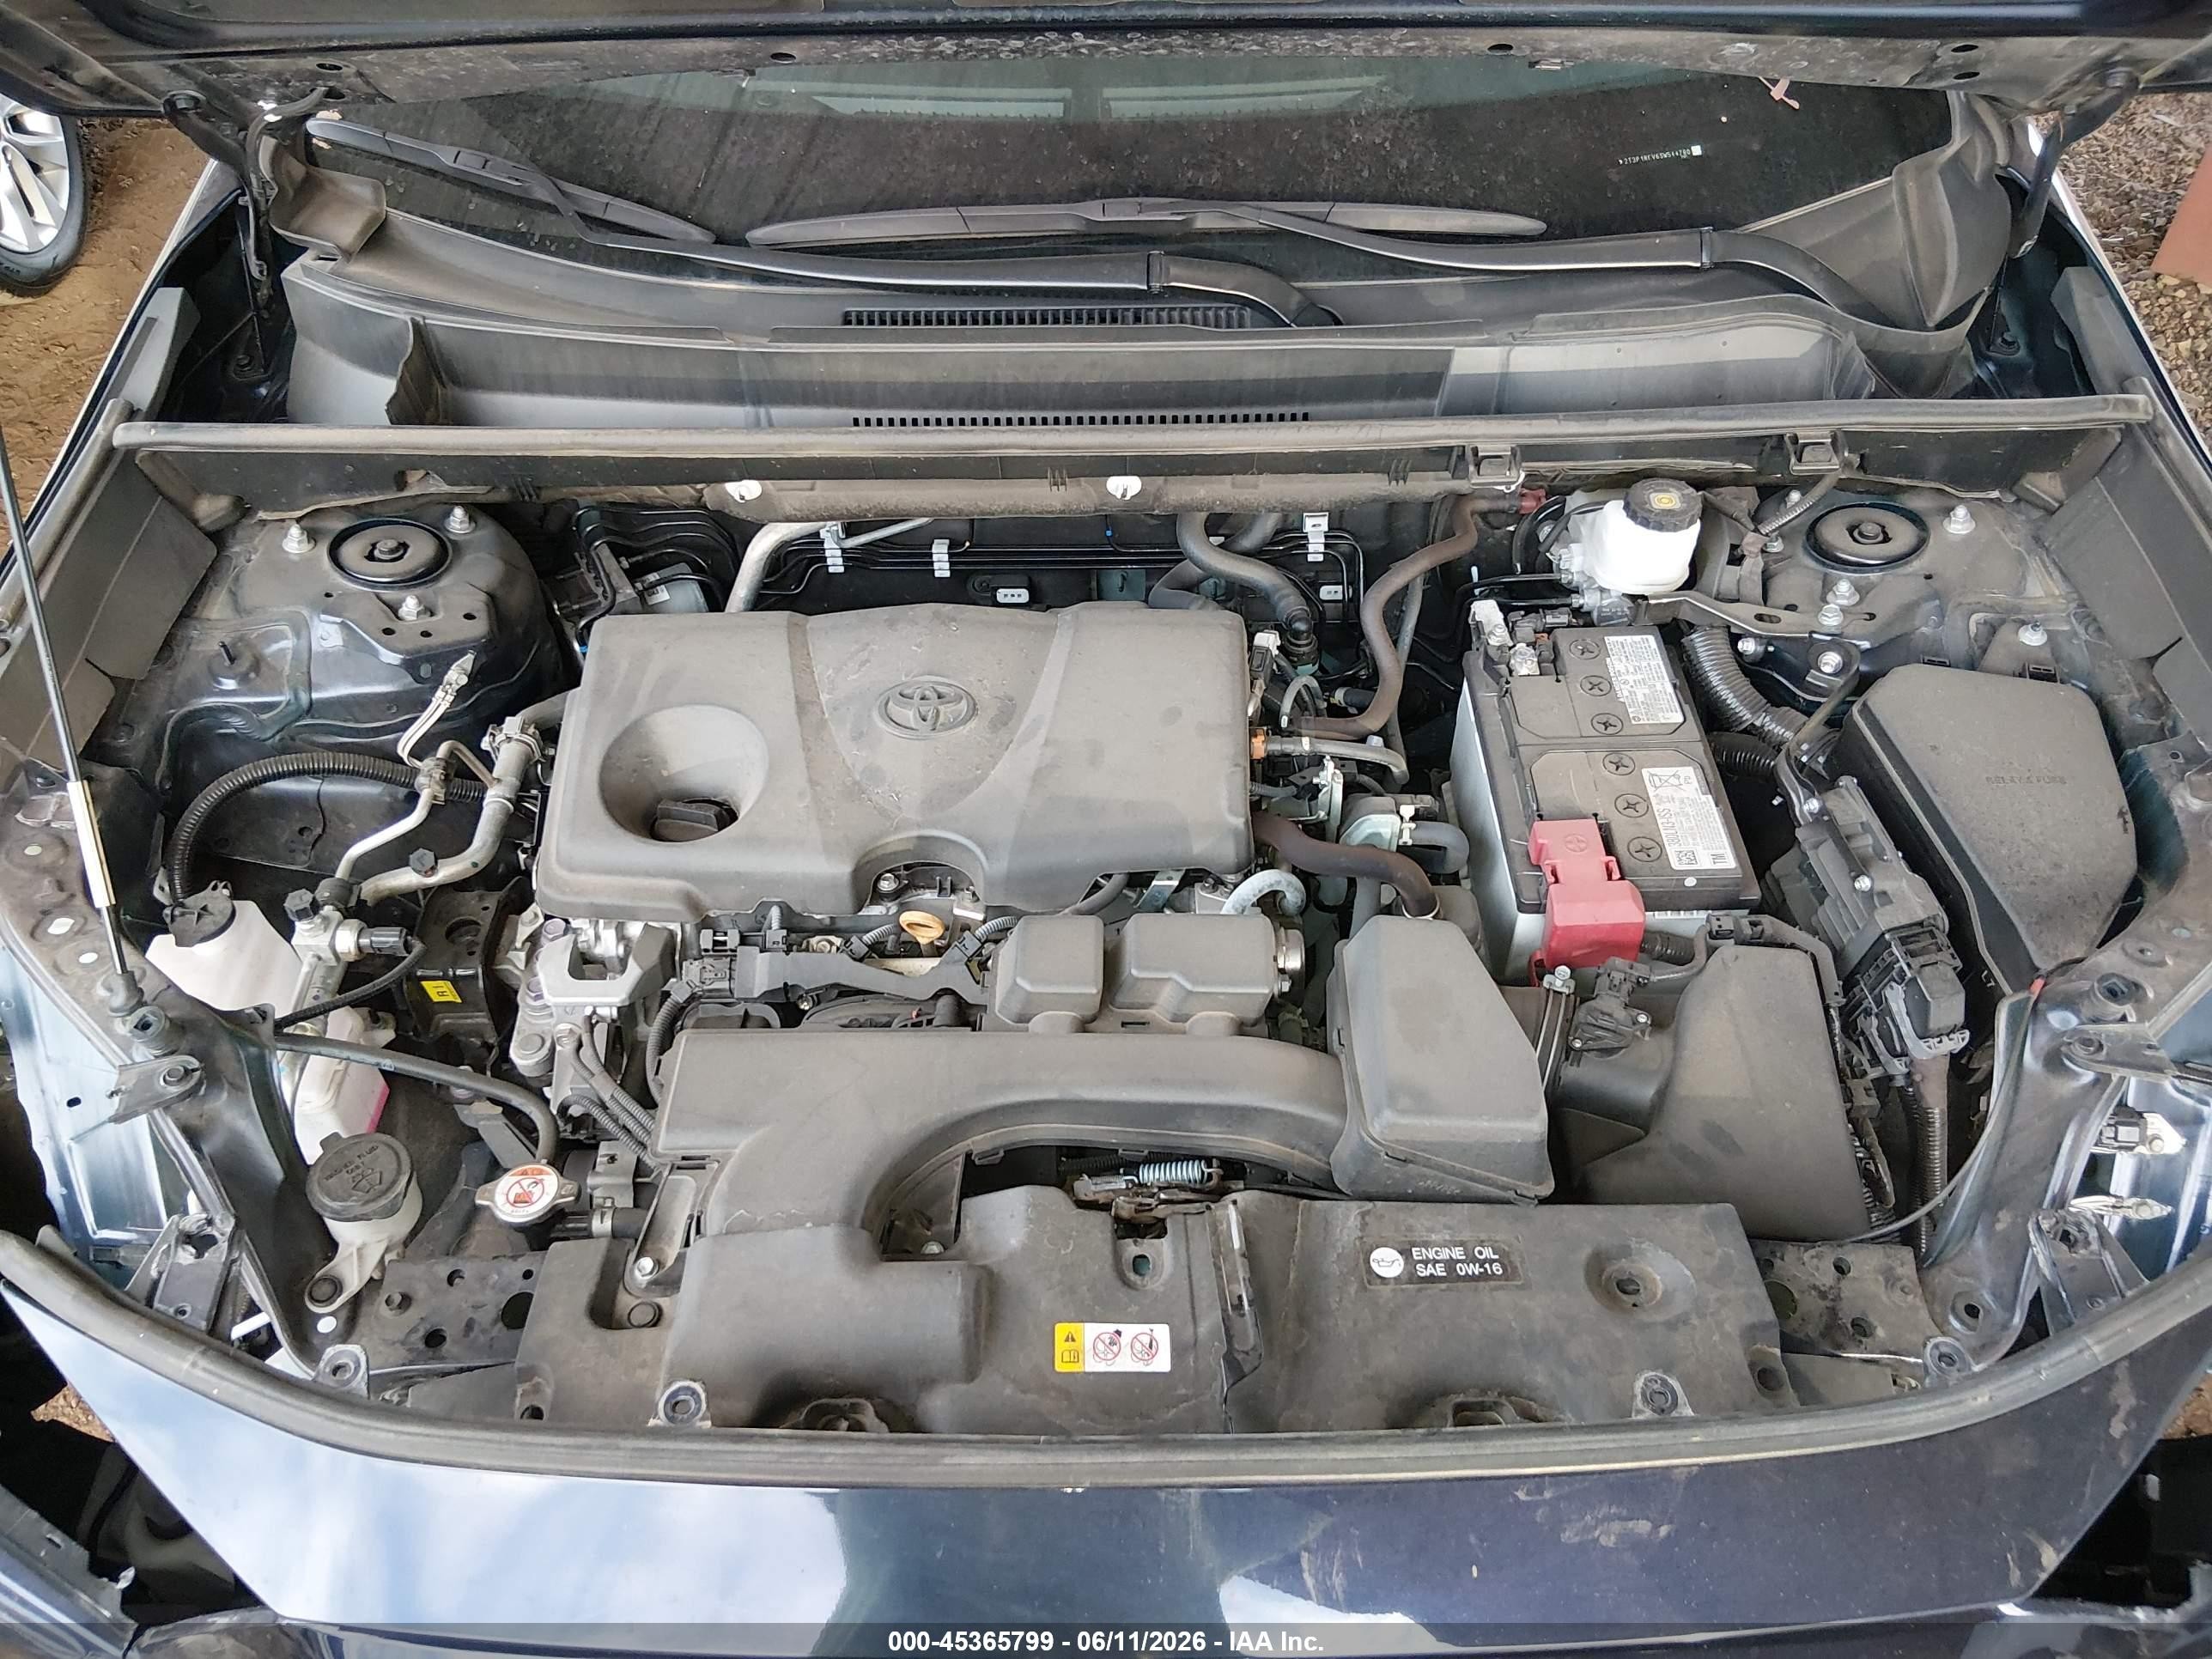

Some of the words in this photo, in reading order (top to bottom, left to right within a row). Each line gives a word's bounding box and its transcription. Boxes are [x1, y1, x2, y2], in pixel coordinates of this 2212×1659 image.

[1411, 1247, 1466, 1260] ENGINE
[1474, 1246, 1499, 1259] OIL
[1415, 1263, 1447, 1277] SAE
[1455, 1262, 1504, 1276] 0W-16
